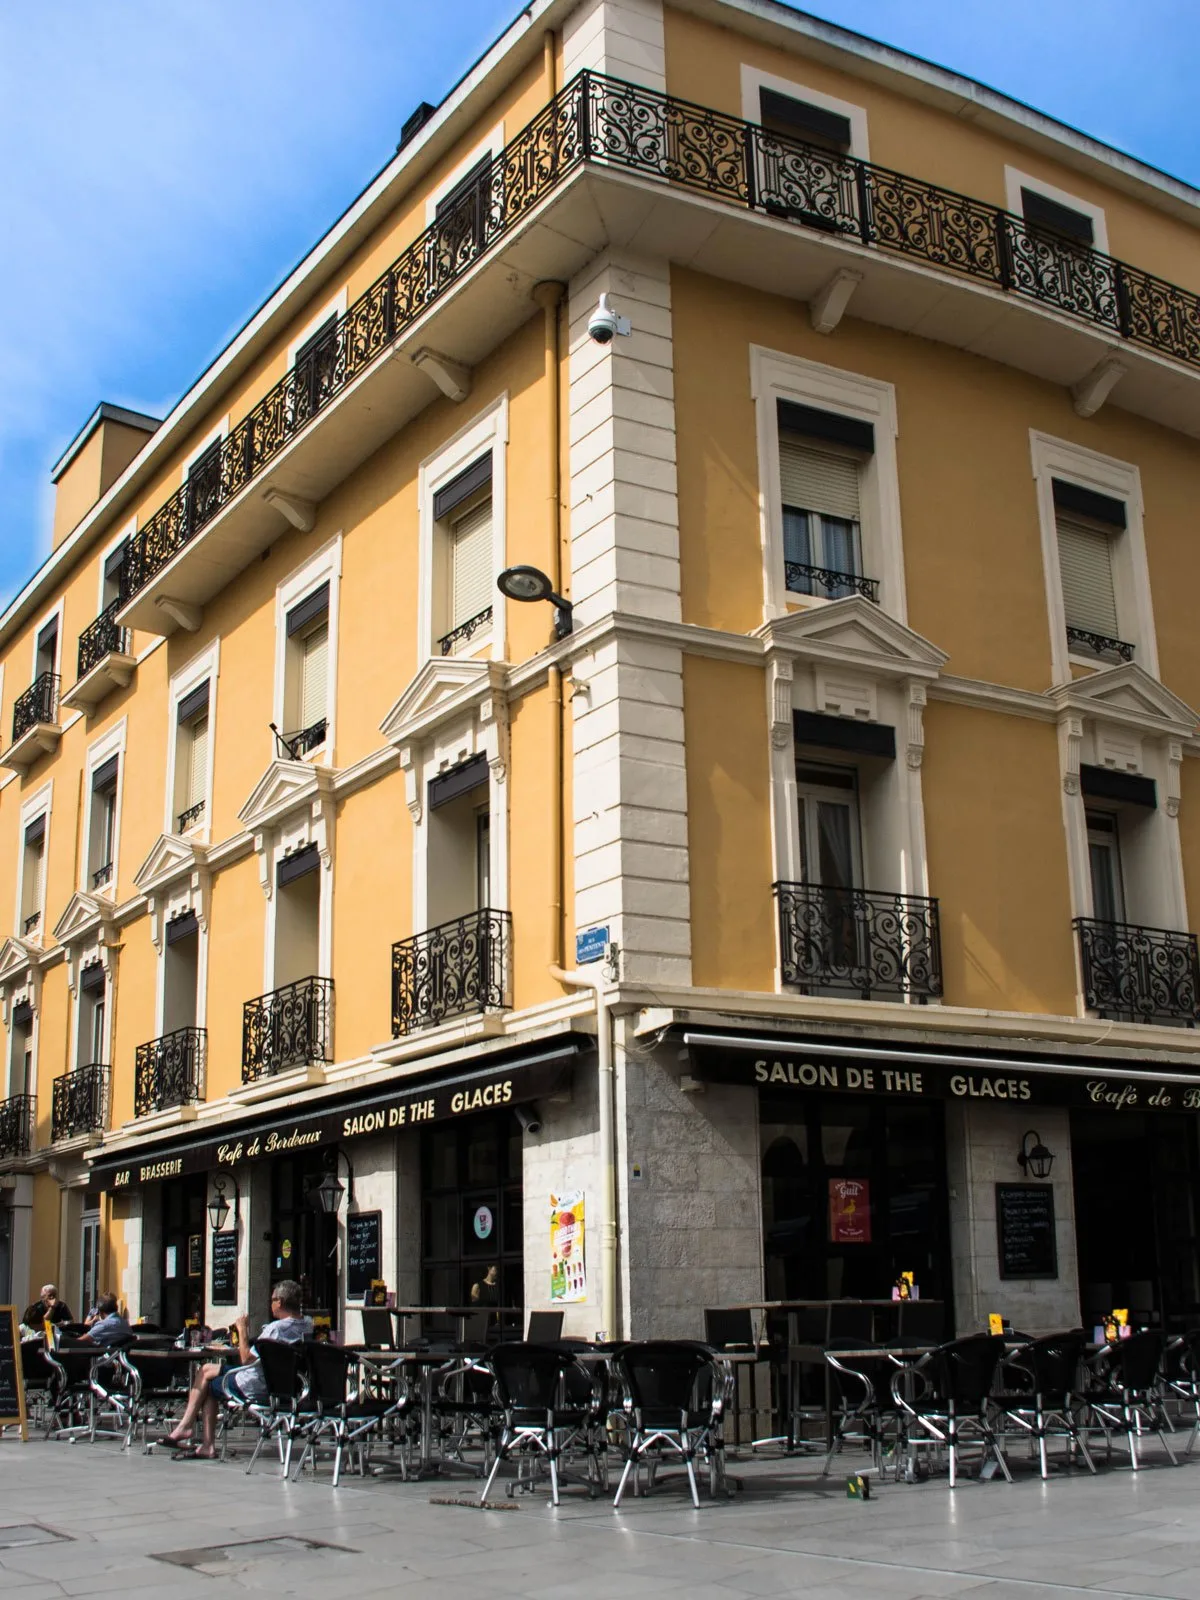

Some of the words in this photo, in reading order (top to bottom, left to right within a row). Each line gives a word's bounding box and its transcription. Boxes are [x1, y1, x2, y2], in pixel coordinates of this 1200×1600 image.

[754, 1060, 839, 1087] SALON
[846, 1067, 875, 1089] DE
[882, 1070, 923, 1093] THE
[950, 1075, 1031, 1100] GLACES
[451, 1080, 513, 1113] GLACES
[1086, 1080, 1138, 1110] Café
[1148, 1086, 1172, 1106] de
[343, 1110, 385, 1137] SALON
[388, 1106, 406, 1127] DE
[410, 1099, 435, 1122] THE
[217, 1142, 243, 1166] Café
[247, 1137, 261, 1157] de
[265, 1128, 323, 1152] Bordeaux
[114, 1171, 130, 1187] BAR
[140, 1158, 183, 1182] BRASSERIE
